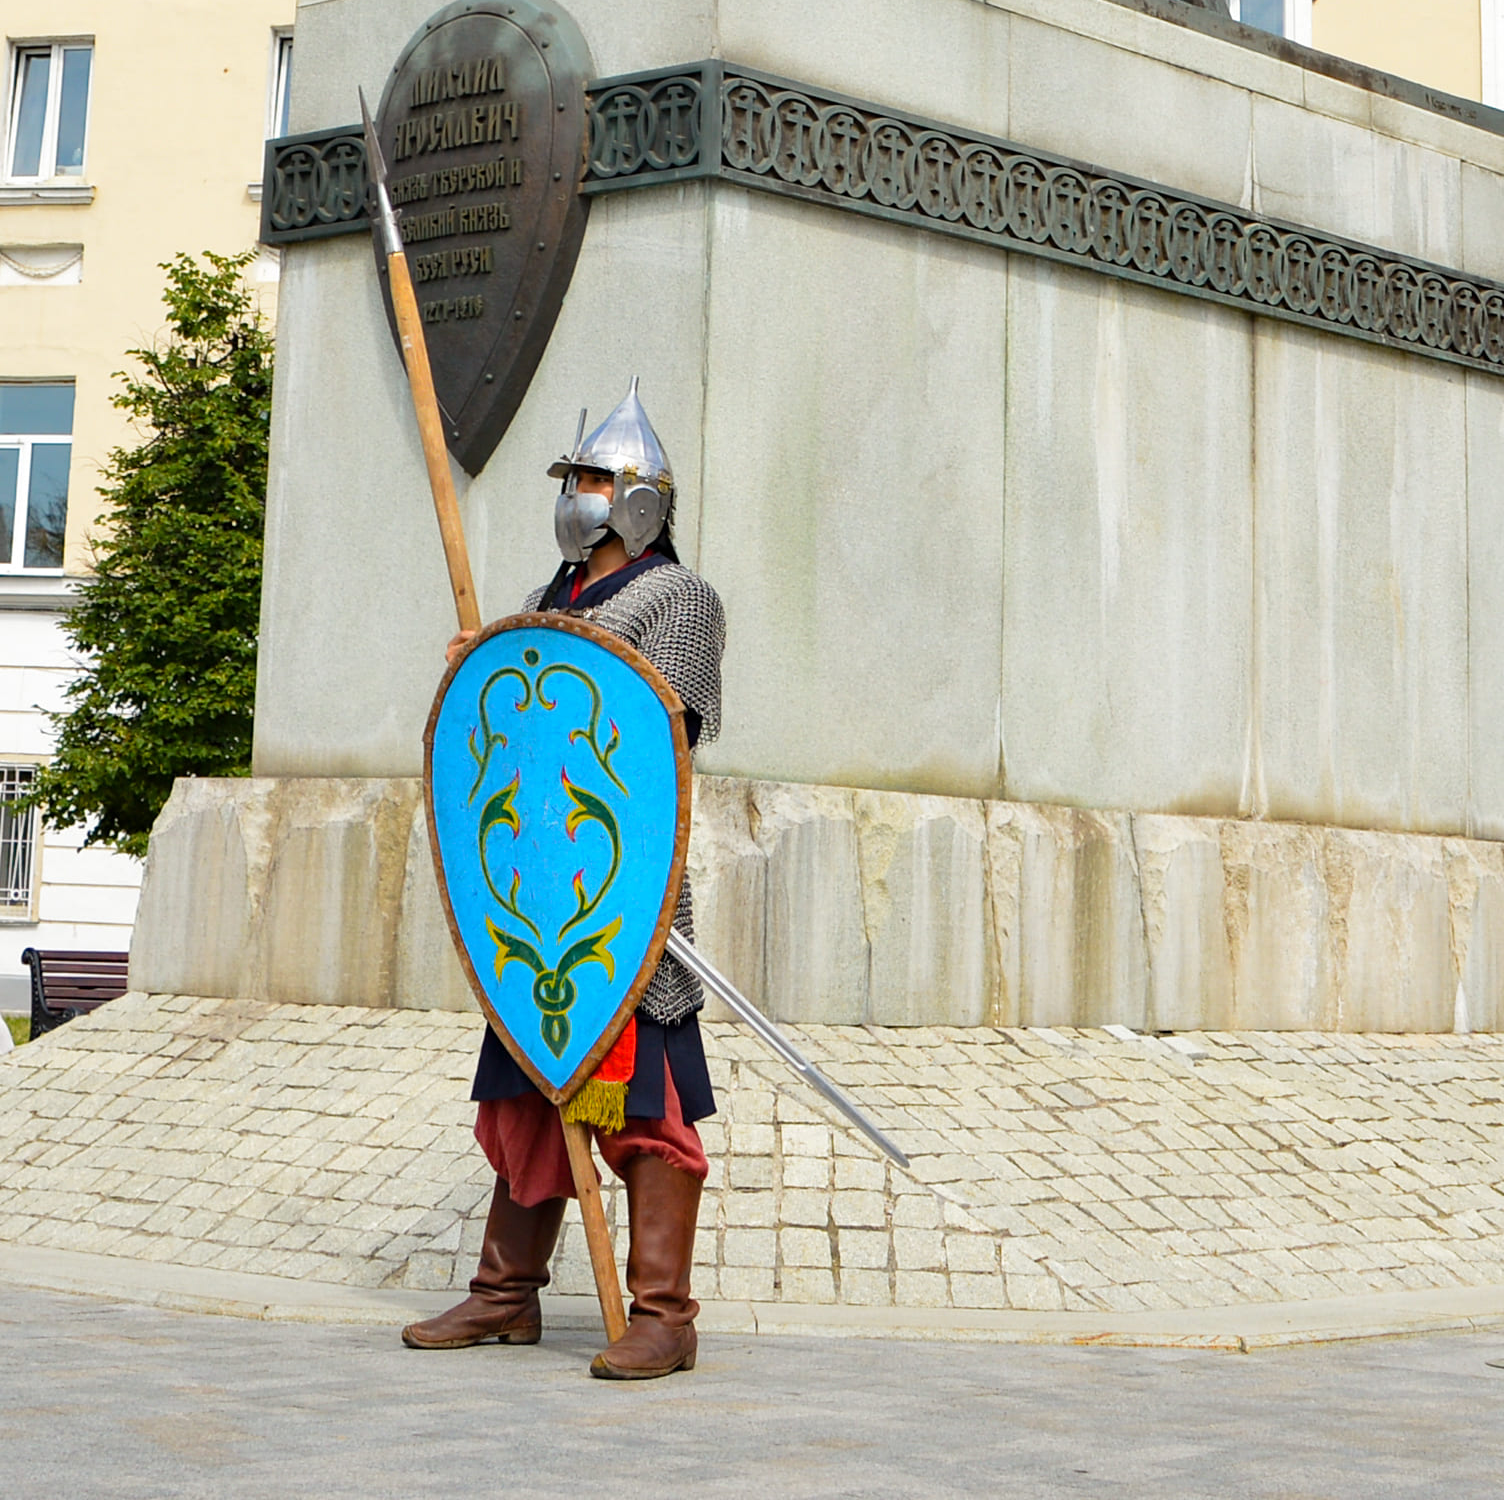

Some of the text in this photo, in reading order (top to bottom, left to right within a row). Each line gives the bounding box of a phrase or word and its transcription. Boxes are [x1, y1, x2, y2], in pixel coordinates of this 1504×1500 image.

[410, 52, 505, 109] МИХАИЛ
[392, 102, 520, 162] ЯРОСЛАВИЧ
[389, 155, 522, 206] КНЯЗЬ ТВЕРСКОЙ И
[398, 202, 511, 245] ВЕЛИКИЙ КНЯЗЬ
[452, 245, 493, 277] РУСИ
